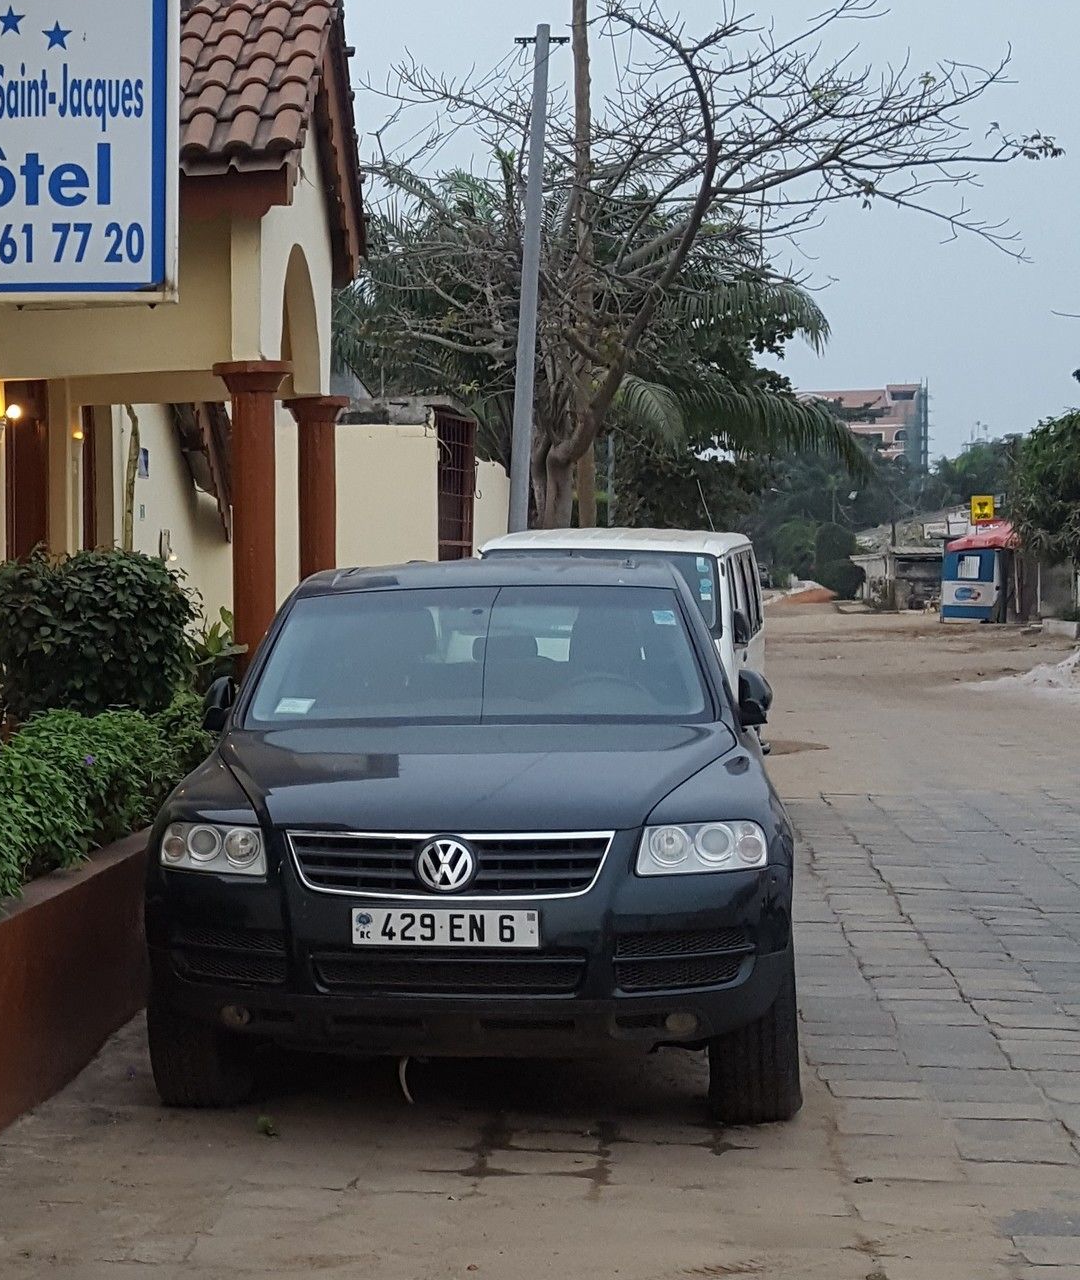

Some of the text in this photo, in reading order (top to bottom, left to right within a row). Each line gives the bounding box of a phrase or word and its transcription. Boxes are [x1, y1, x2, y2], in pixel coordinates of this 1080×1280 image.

[51, 222, 93, 264] 77
[103, 221, 146, 264] 20
[381, 912, 516, 943] 429 EN 6
